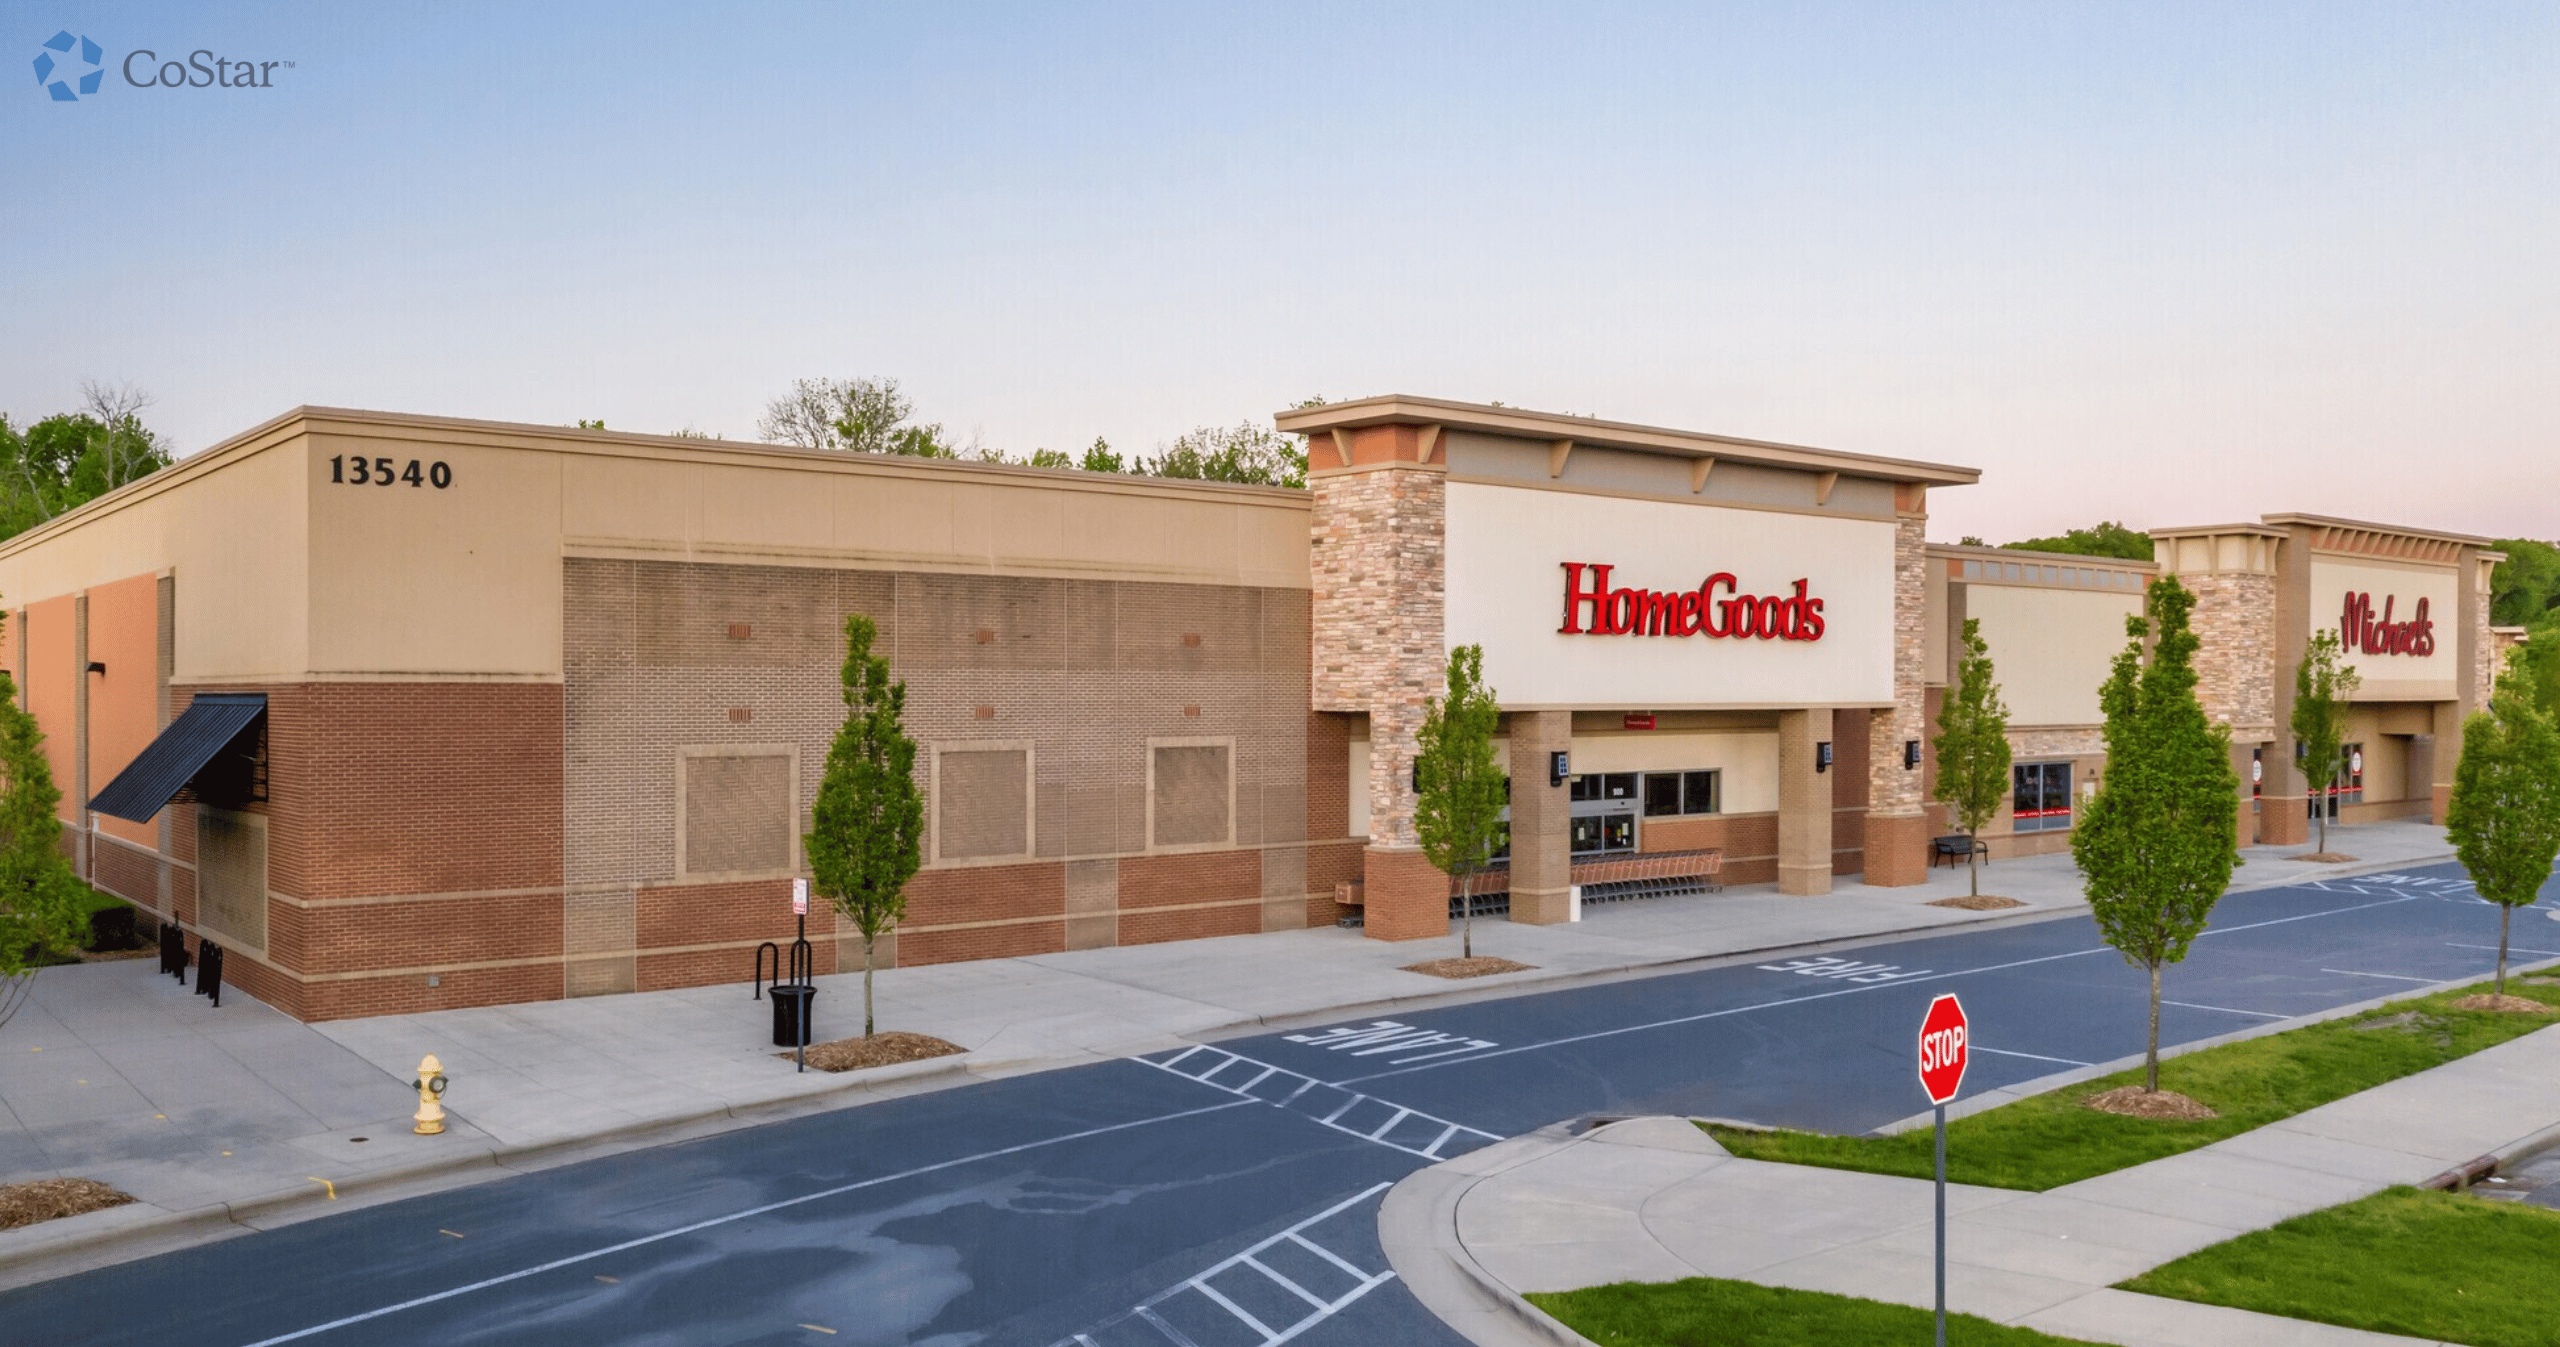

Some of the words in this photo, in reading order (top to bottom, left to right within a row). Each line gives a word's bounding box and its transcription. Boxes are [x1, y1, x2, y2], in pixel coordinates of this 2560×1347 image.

[329, 454, 452, 490] 13540
[1557, 561, 1826, 641] HomeGoods
[2340, 590, 2435, 658] Michaels
[1755, 956, 1934, 984] FIRE
[1281, 1020, 1500, 1065] LANE
[1923, 1025, 1965, 1074] STOP
